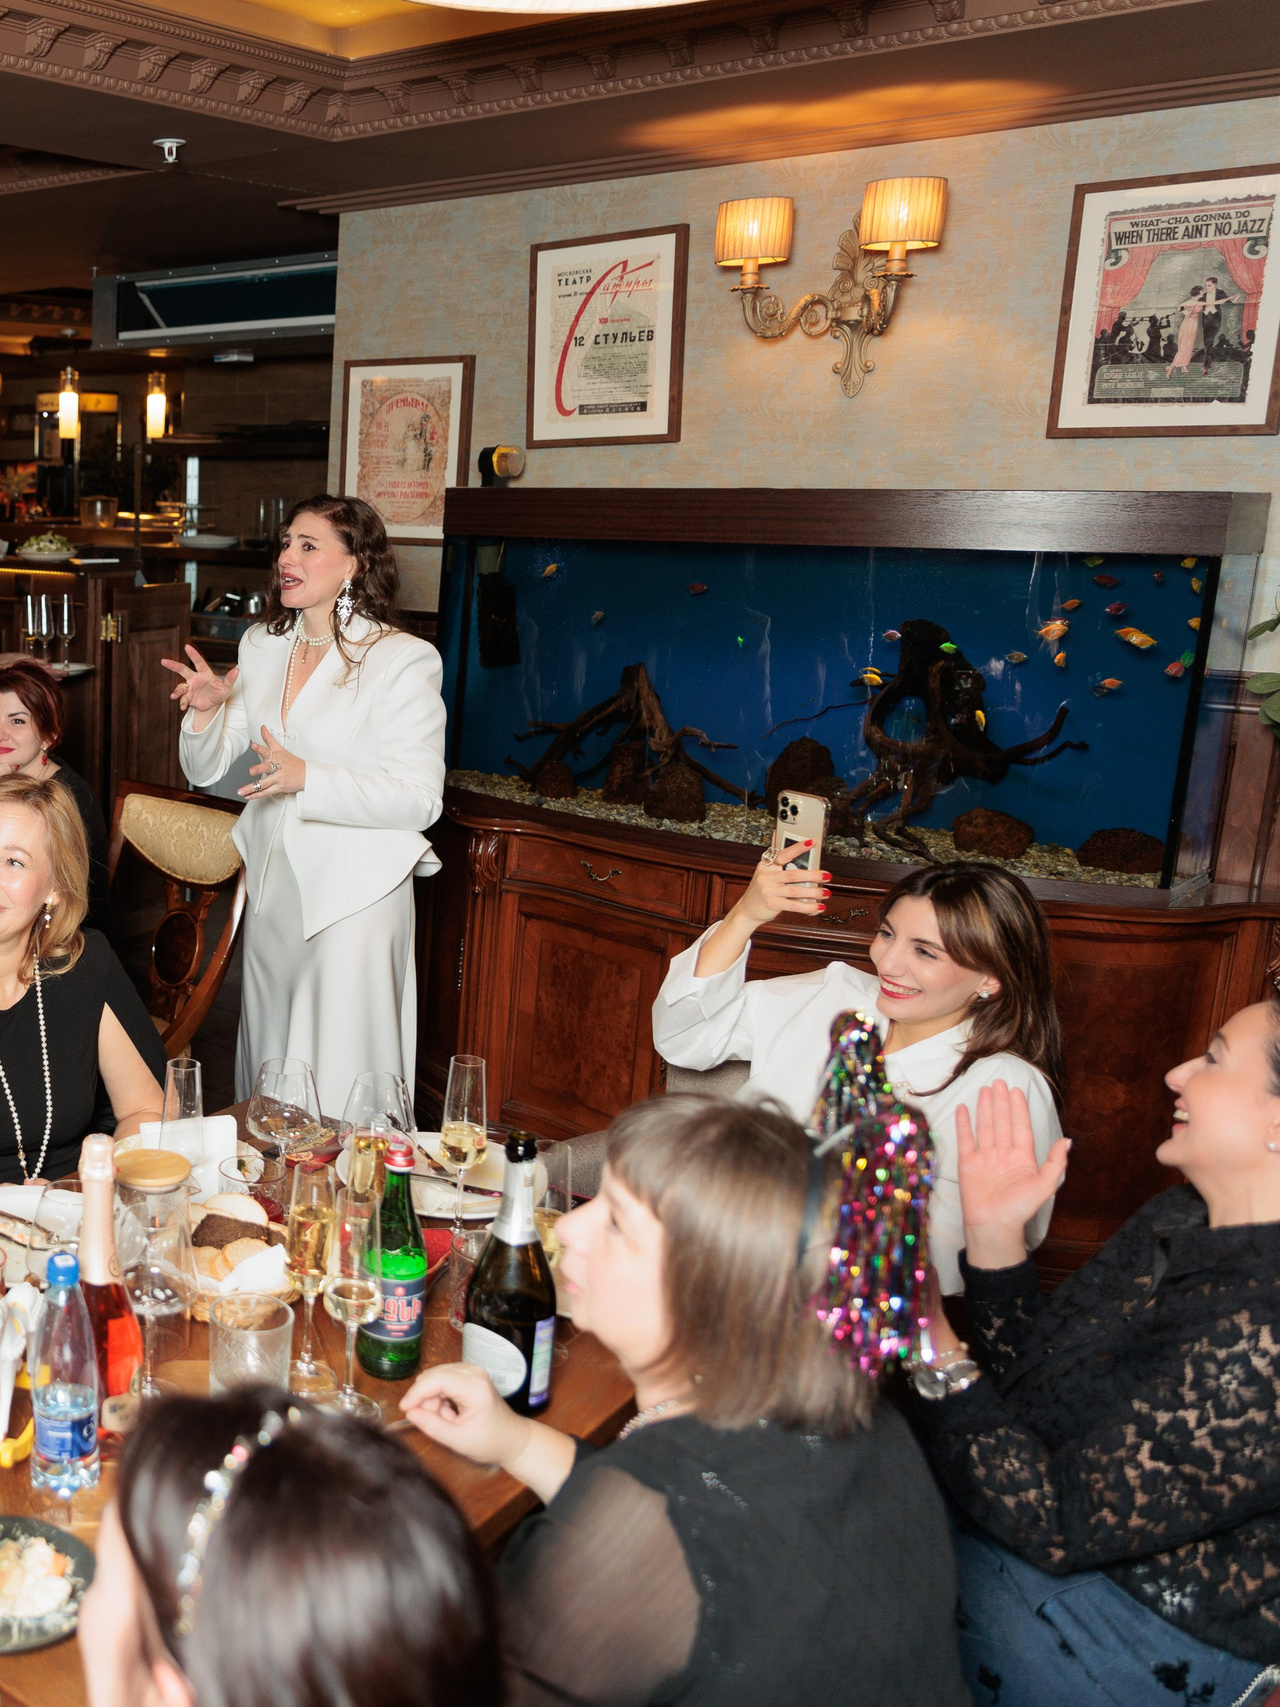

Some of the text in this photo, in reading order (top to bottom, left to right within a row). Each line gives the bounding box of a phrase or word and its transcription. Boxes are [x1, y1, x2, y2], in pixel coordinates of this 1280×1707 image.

[1130, 210, 1250, 228] WHAT-CHA GONNA DO
[1114, 218, 1266, 246] WHEN THERE AINT NO JAZZ
[557, 275, 592, 287] ТЕАТР
[573, 336, 585, 347] 12
[593, 329, 655, 345] СТУЛЬЕВ
